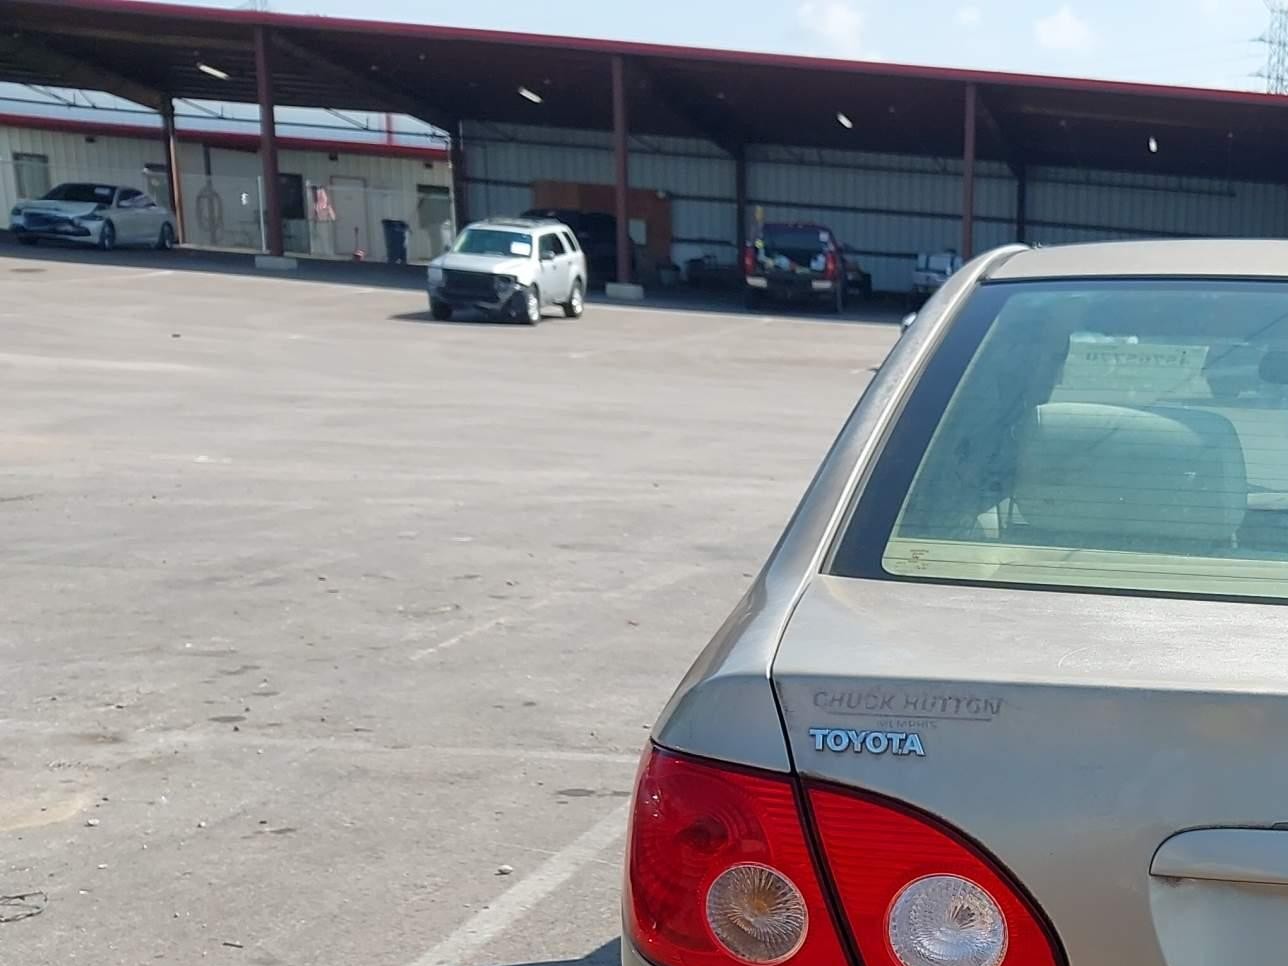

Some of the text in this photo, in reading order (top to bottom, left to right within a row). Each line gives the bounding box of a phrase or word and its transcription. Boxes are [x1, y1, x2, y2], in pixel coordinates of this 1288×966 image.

[813, 690, 1004, 715] CHUCK HUTTON
[809, 728, 926, 756] TOYOTA
